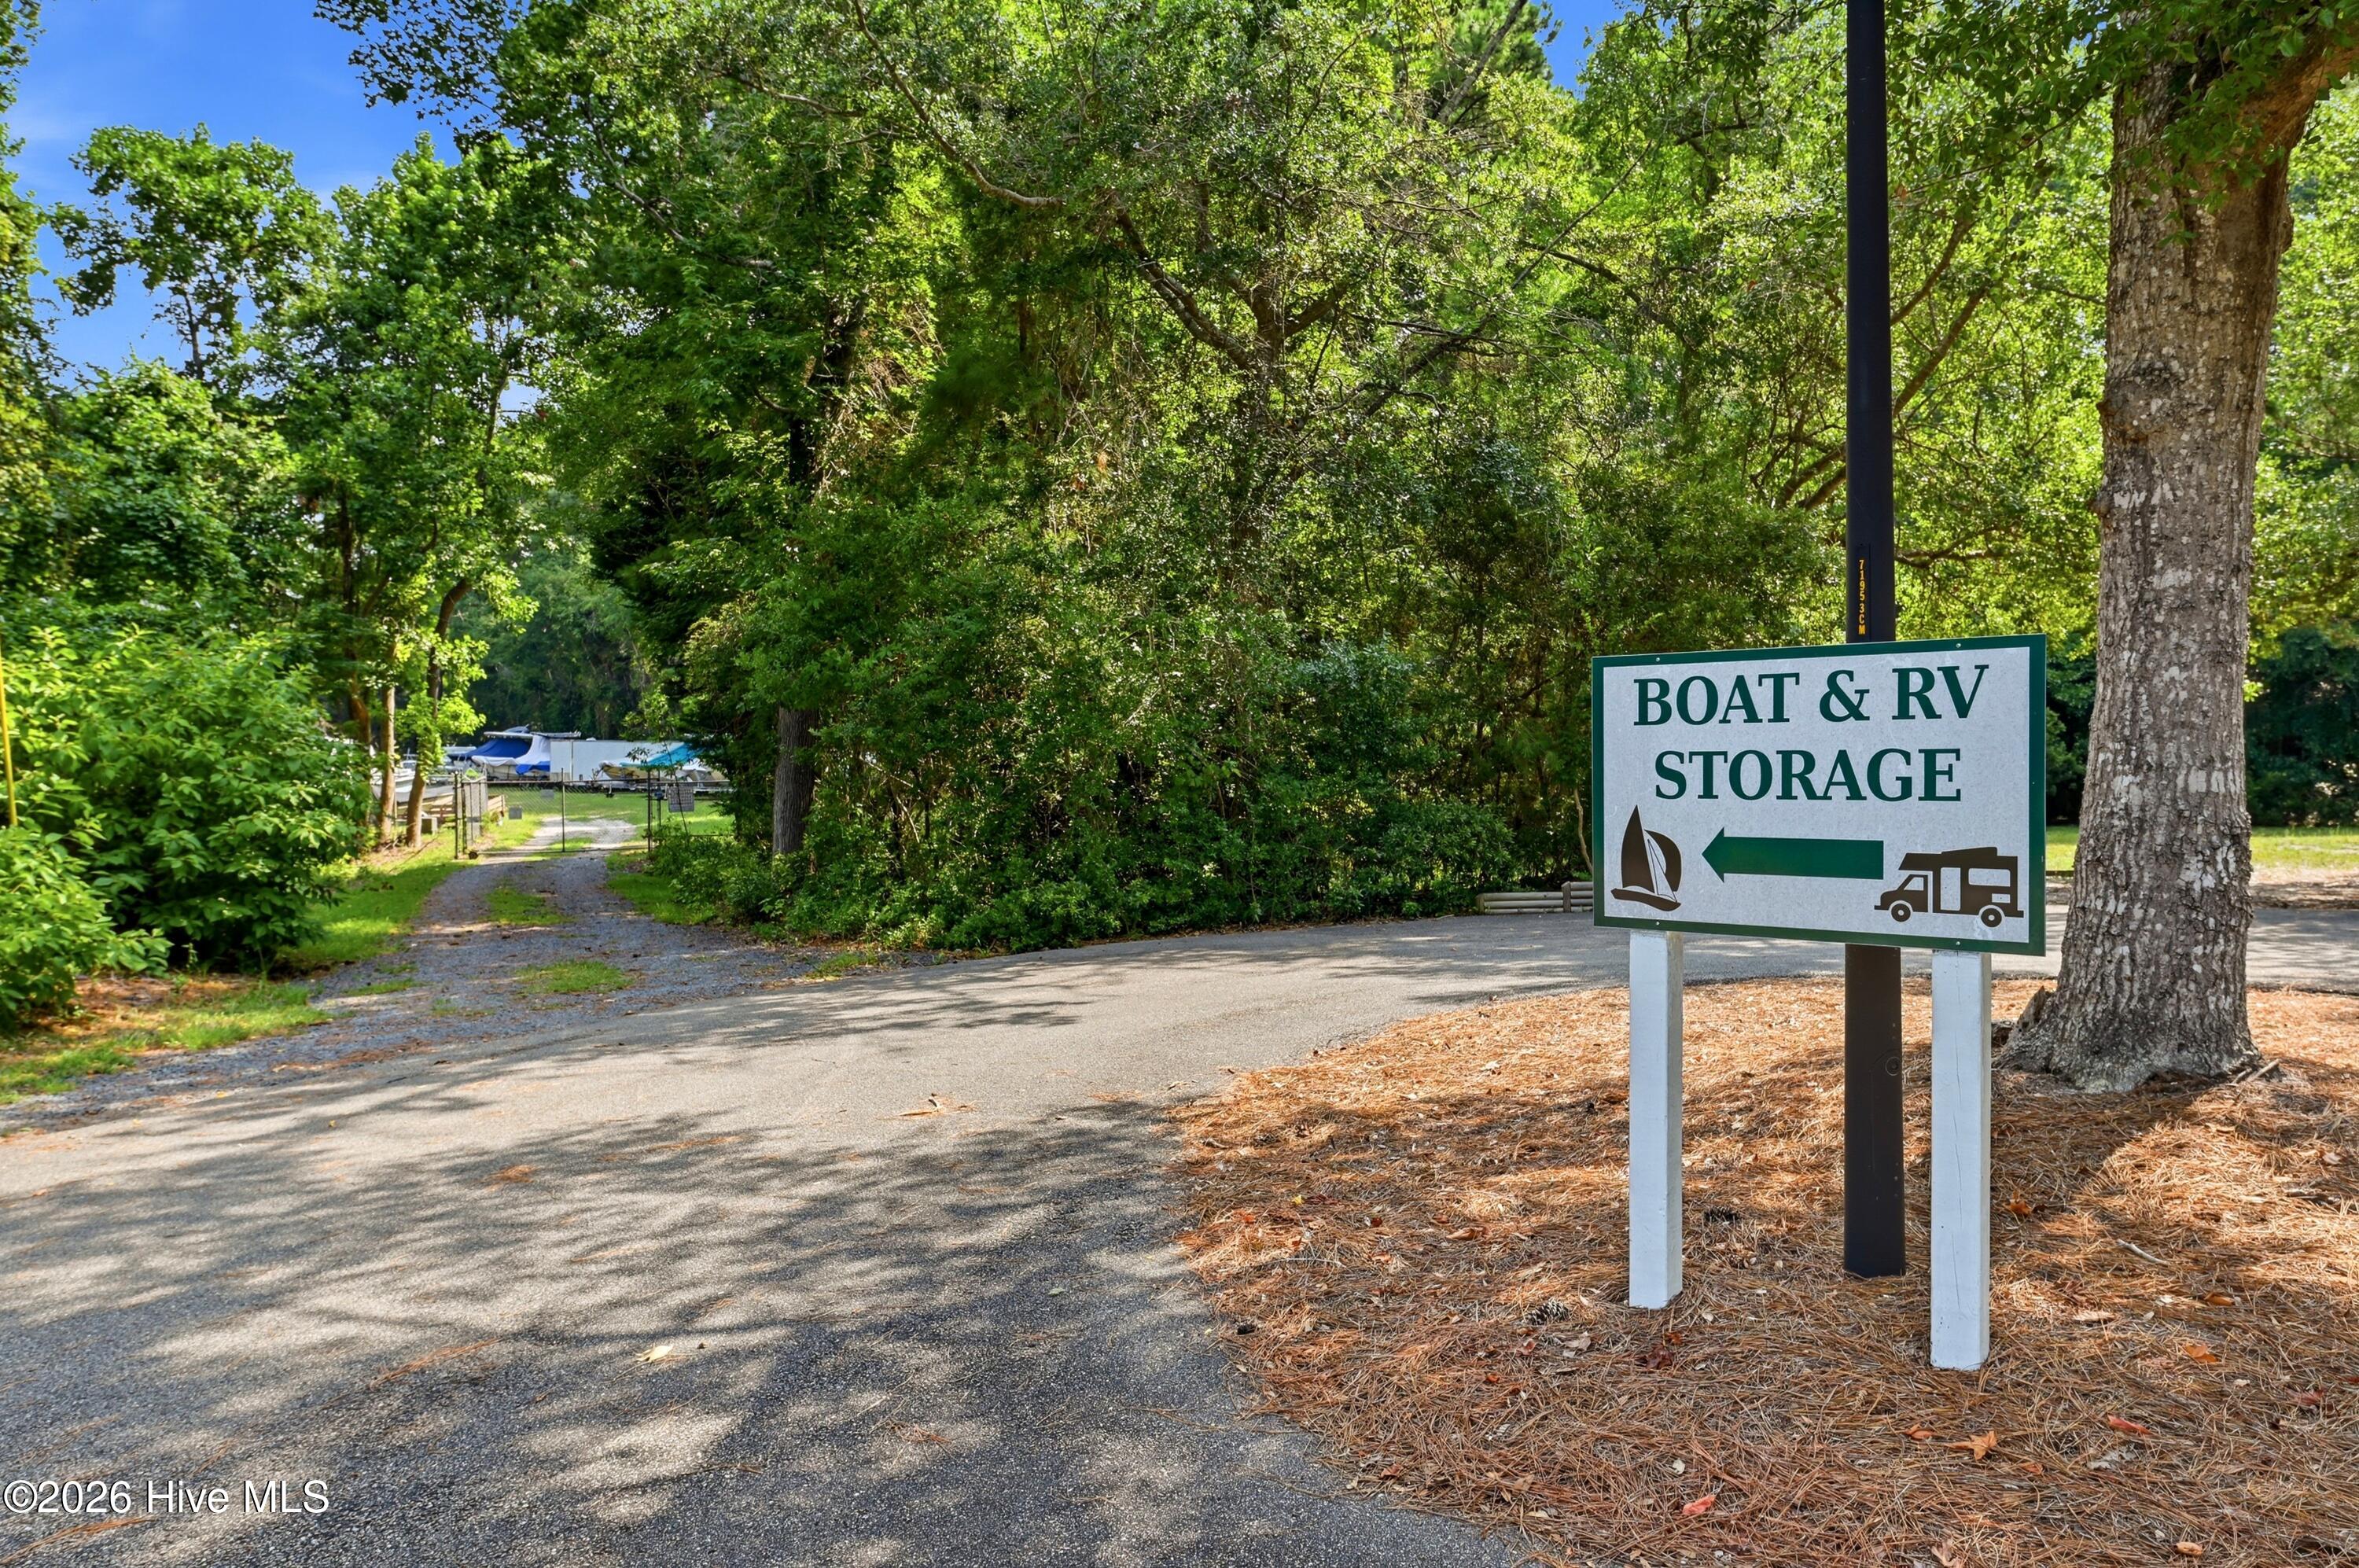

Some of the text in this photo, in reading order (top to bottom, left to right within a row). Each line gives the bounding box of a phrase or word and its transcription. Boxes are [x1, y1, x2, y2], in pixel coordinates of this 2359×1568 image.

[1633, 664, 1989, 726] BOAT & RV
[1654, 748, 1962, 802] STORAGE
